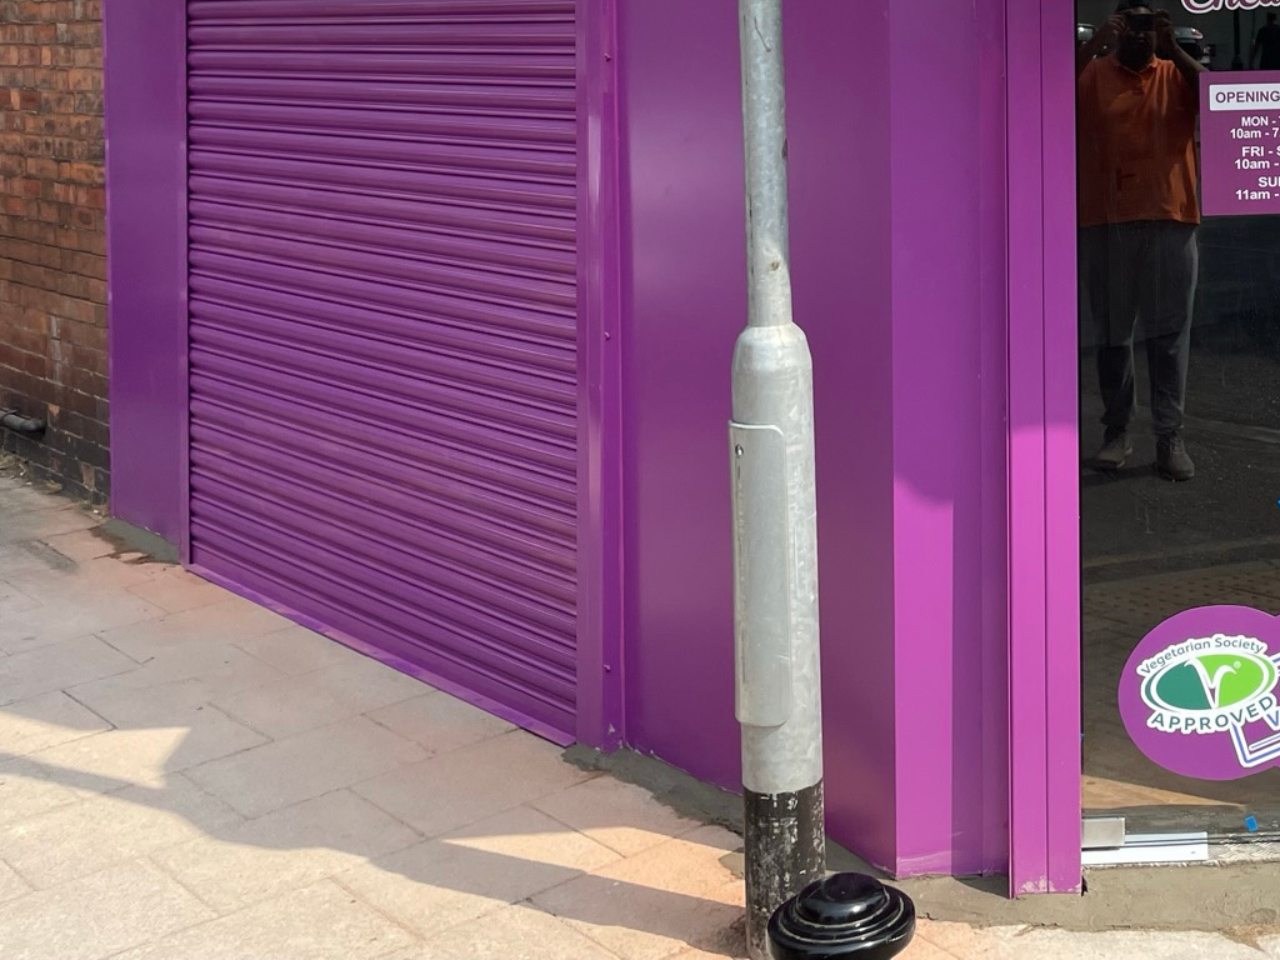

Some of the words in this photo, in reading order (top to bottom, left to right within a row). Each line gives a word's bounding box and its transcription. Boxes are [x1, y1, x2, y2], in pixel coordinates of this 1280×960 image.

[1215, 89, 1280, 104] OPENING
[1241, 116, 1268, 127] MON
[1230, 127, 1262, 139] 10am
[1241, 146, 1265, 157] FRI
[1234, 158, 1270, 169] 10am
[1235, 189, 1270, 200] 11am
[1141, 639, 1211, 675] Vegetarian
[1214, 637, 1264, 654] Society
[1151, 695, 1273, 731] APPROVED
